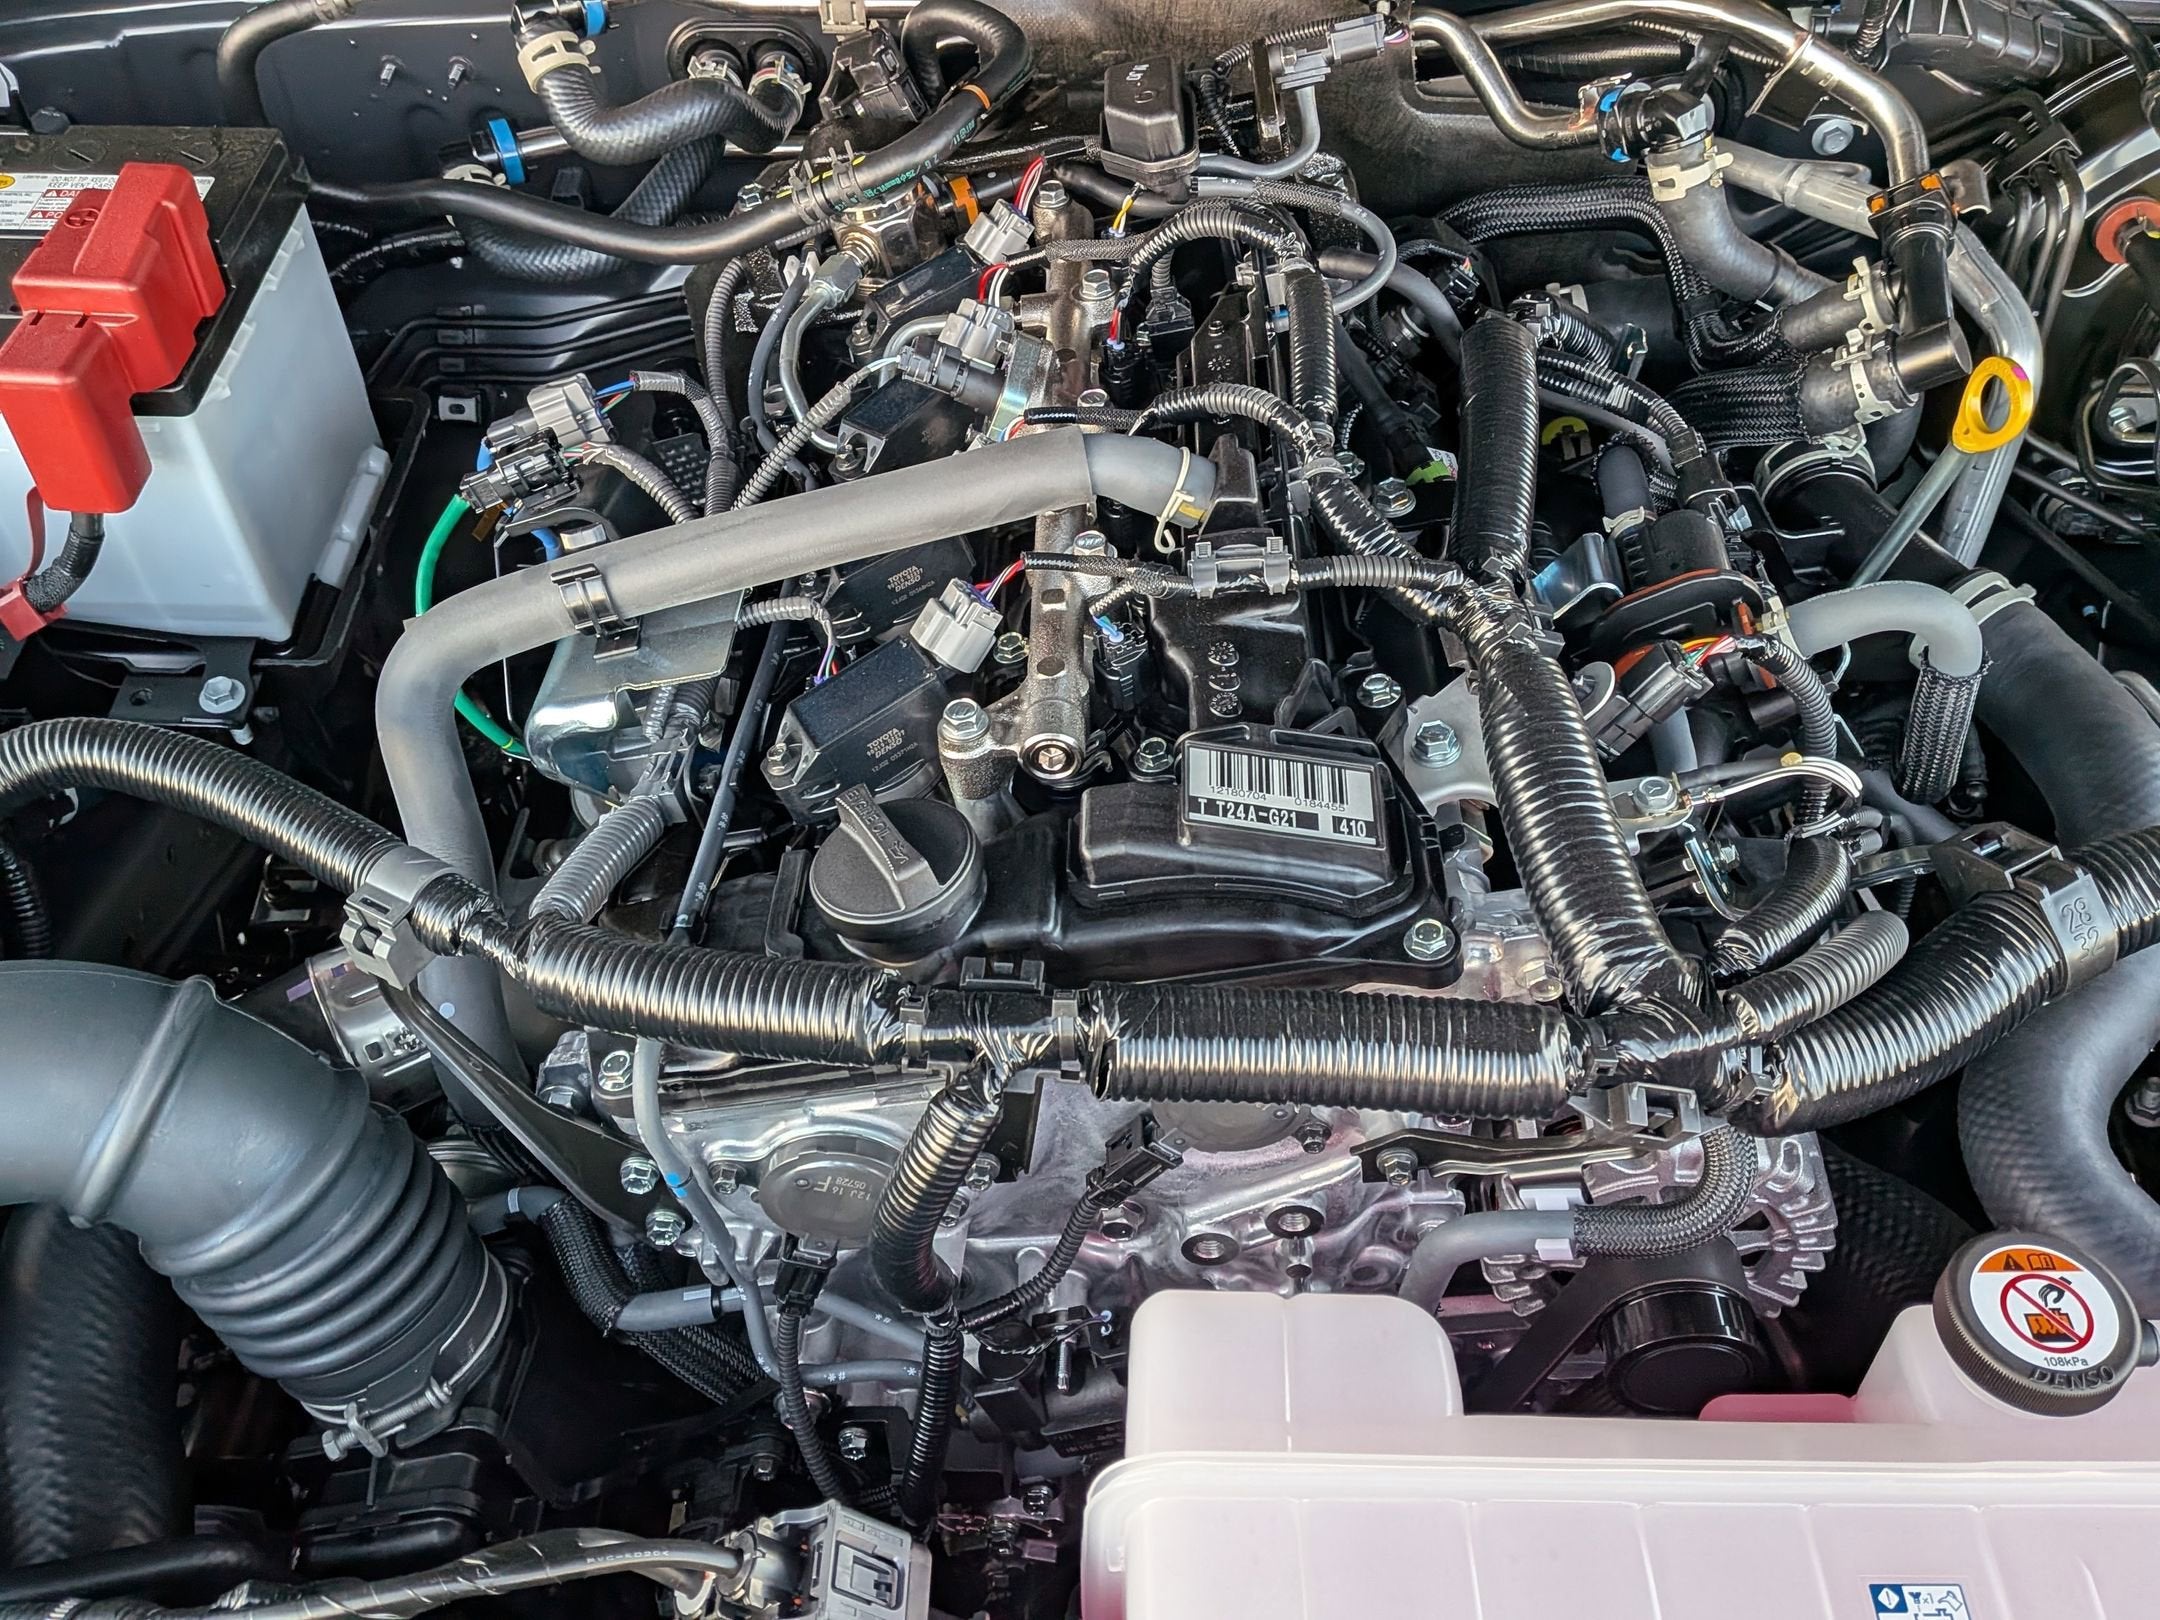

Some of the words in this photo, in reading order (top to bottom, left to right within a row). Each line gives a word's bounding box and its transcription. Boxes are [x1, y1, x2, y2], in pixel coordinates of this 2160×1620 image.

[887, 566, 919, 583] TOYOTA
[895, 576, 920, 592] DENSO
[867, 728, 900, 748] TOYOTA
[875, 738, 903, 758] DENSO
[1211, 785, 1267, 801] 12180704
[1294, 797, 1345, 812] 0184455
[1198, 798, 1208, 815] T
[1216, 800, 1298, 828] T24A-G21
[1339, 819, 1367, 838] 410
[871, 822, 891, 841] OIL
[2061, 896, 2094, 935] 28
[2043, 1356, 2089, 1368] 108kPa
[2029, 1366, 2115, 1391] DENSO
